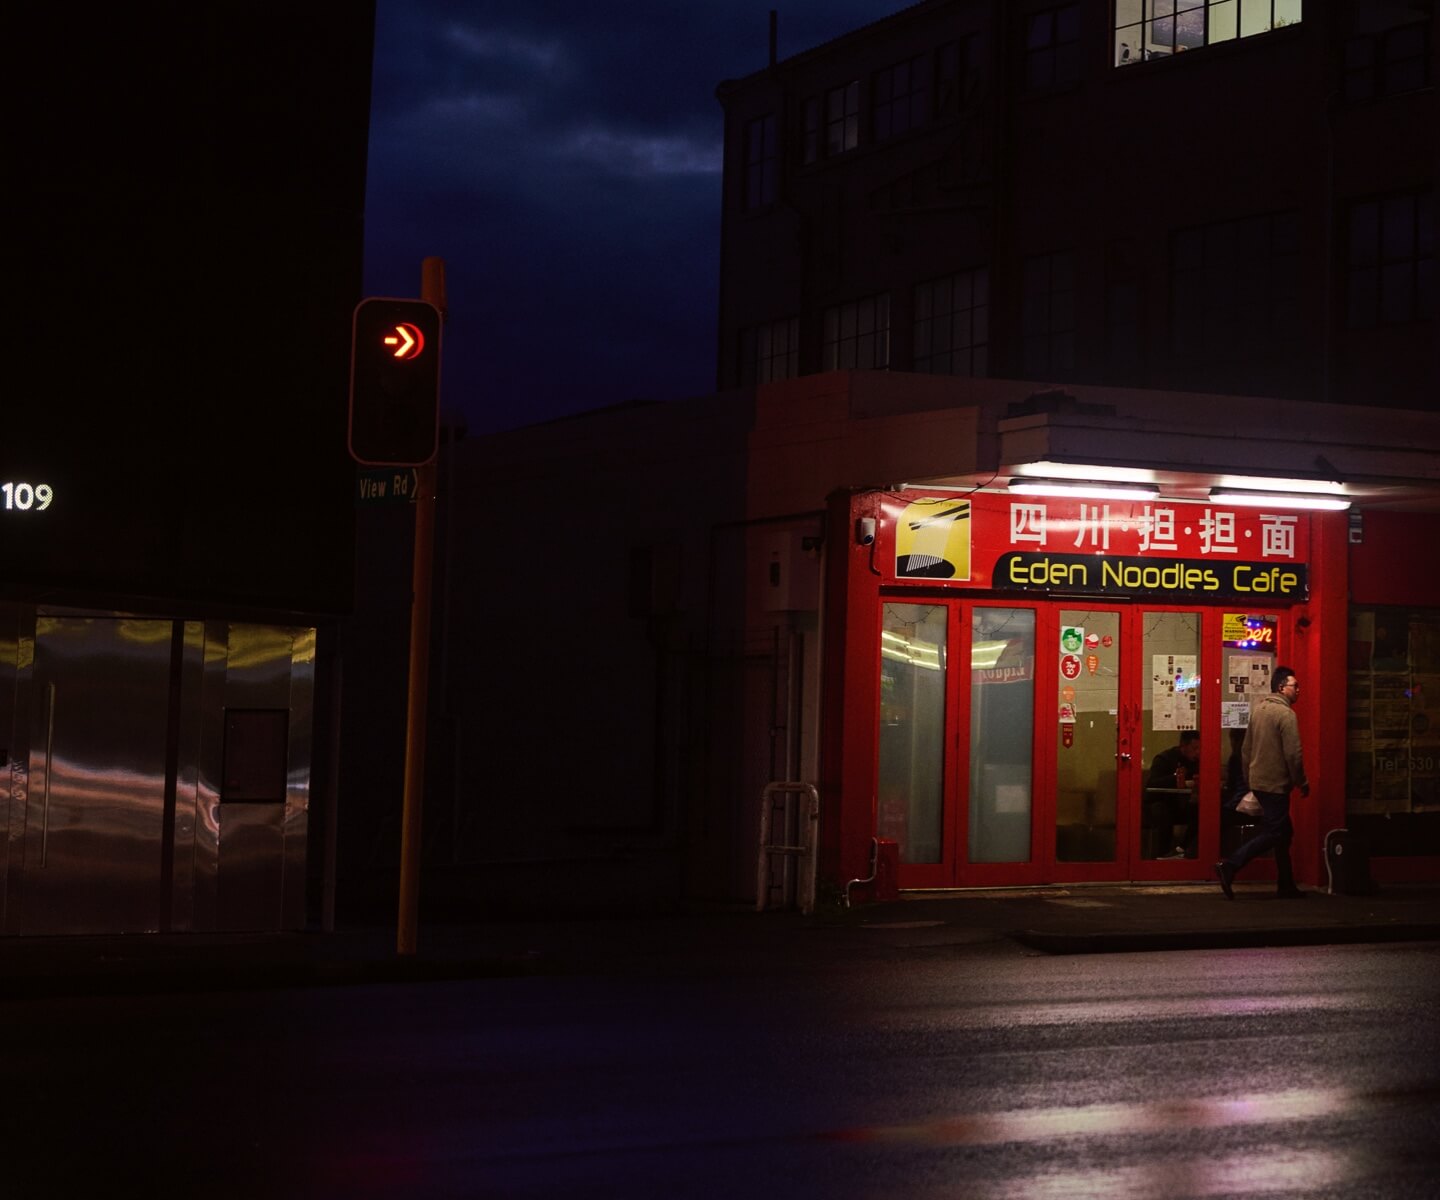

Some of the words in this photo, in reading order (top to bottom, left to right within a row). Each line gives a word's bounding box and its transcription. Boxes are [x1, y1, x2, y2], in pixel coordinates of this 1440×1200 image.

[2, 482, 53, 510] 109
[360, 478, 387, 500] View
[393, 474, 408, 497] Rd
[1010, 556, 1087, 586] Eden
[1102, 560, 1219, 590] Noodles
[1233, 565, 1297, 593] Cafe
[1246, 627, 1272, 642] pen
[1408, 757, 1433, 771] 630
